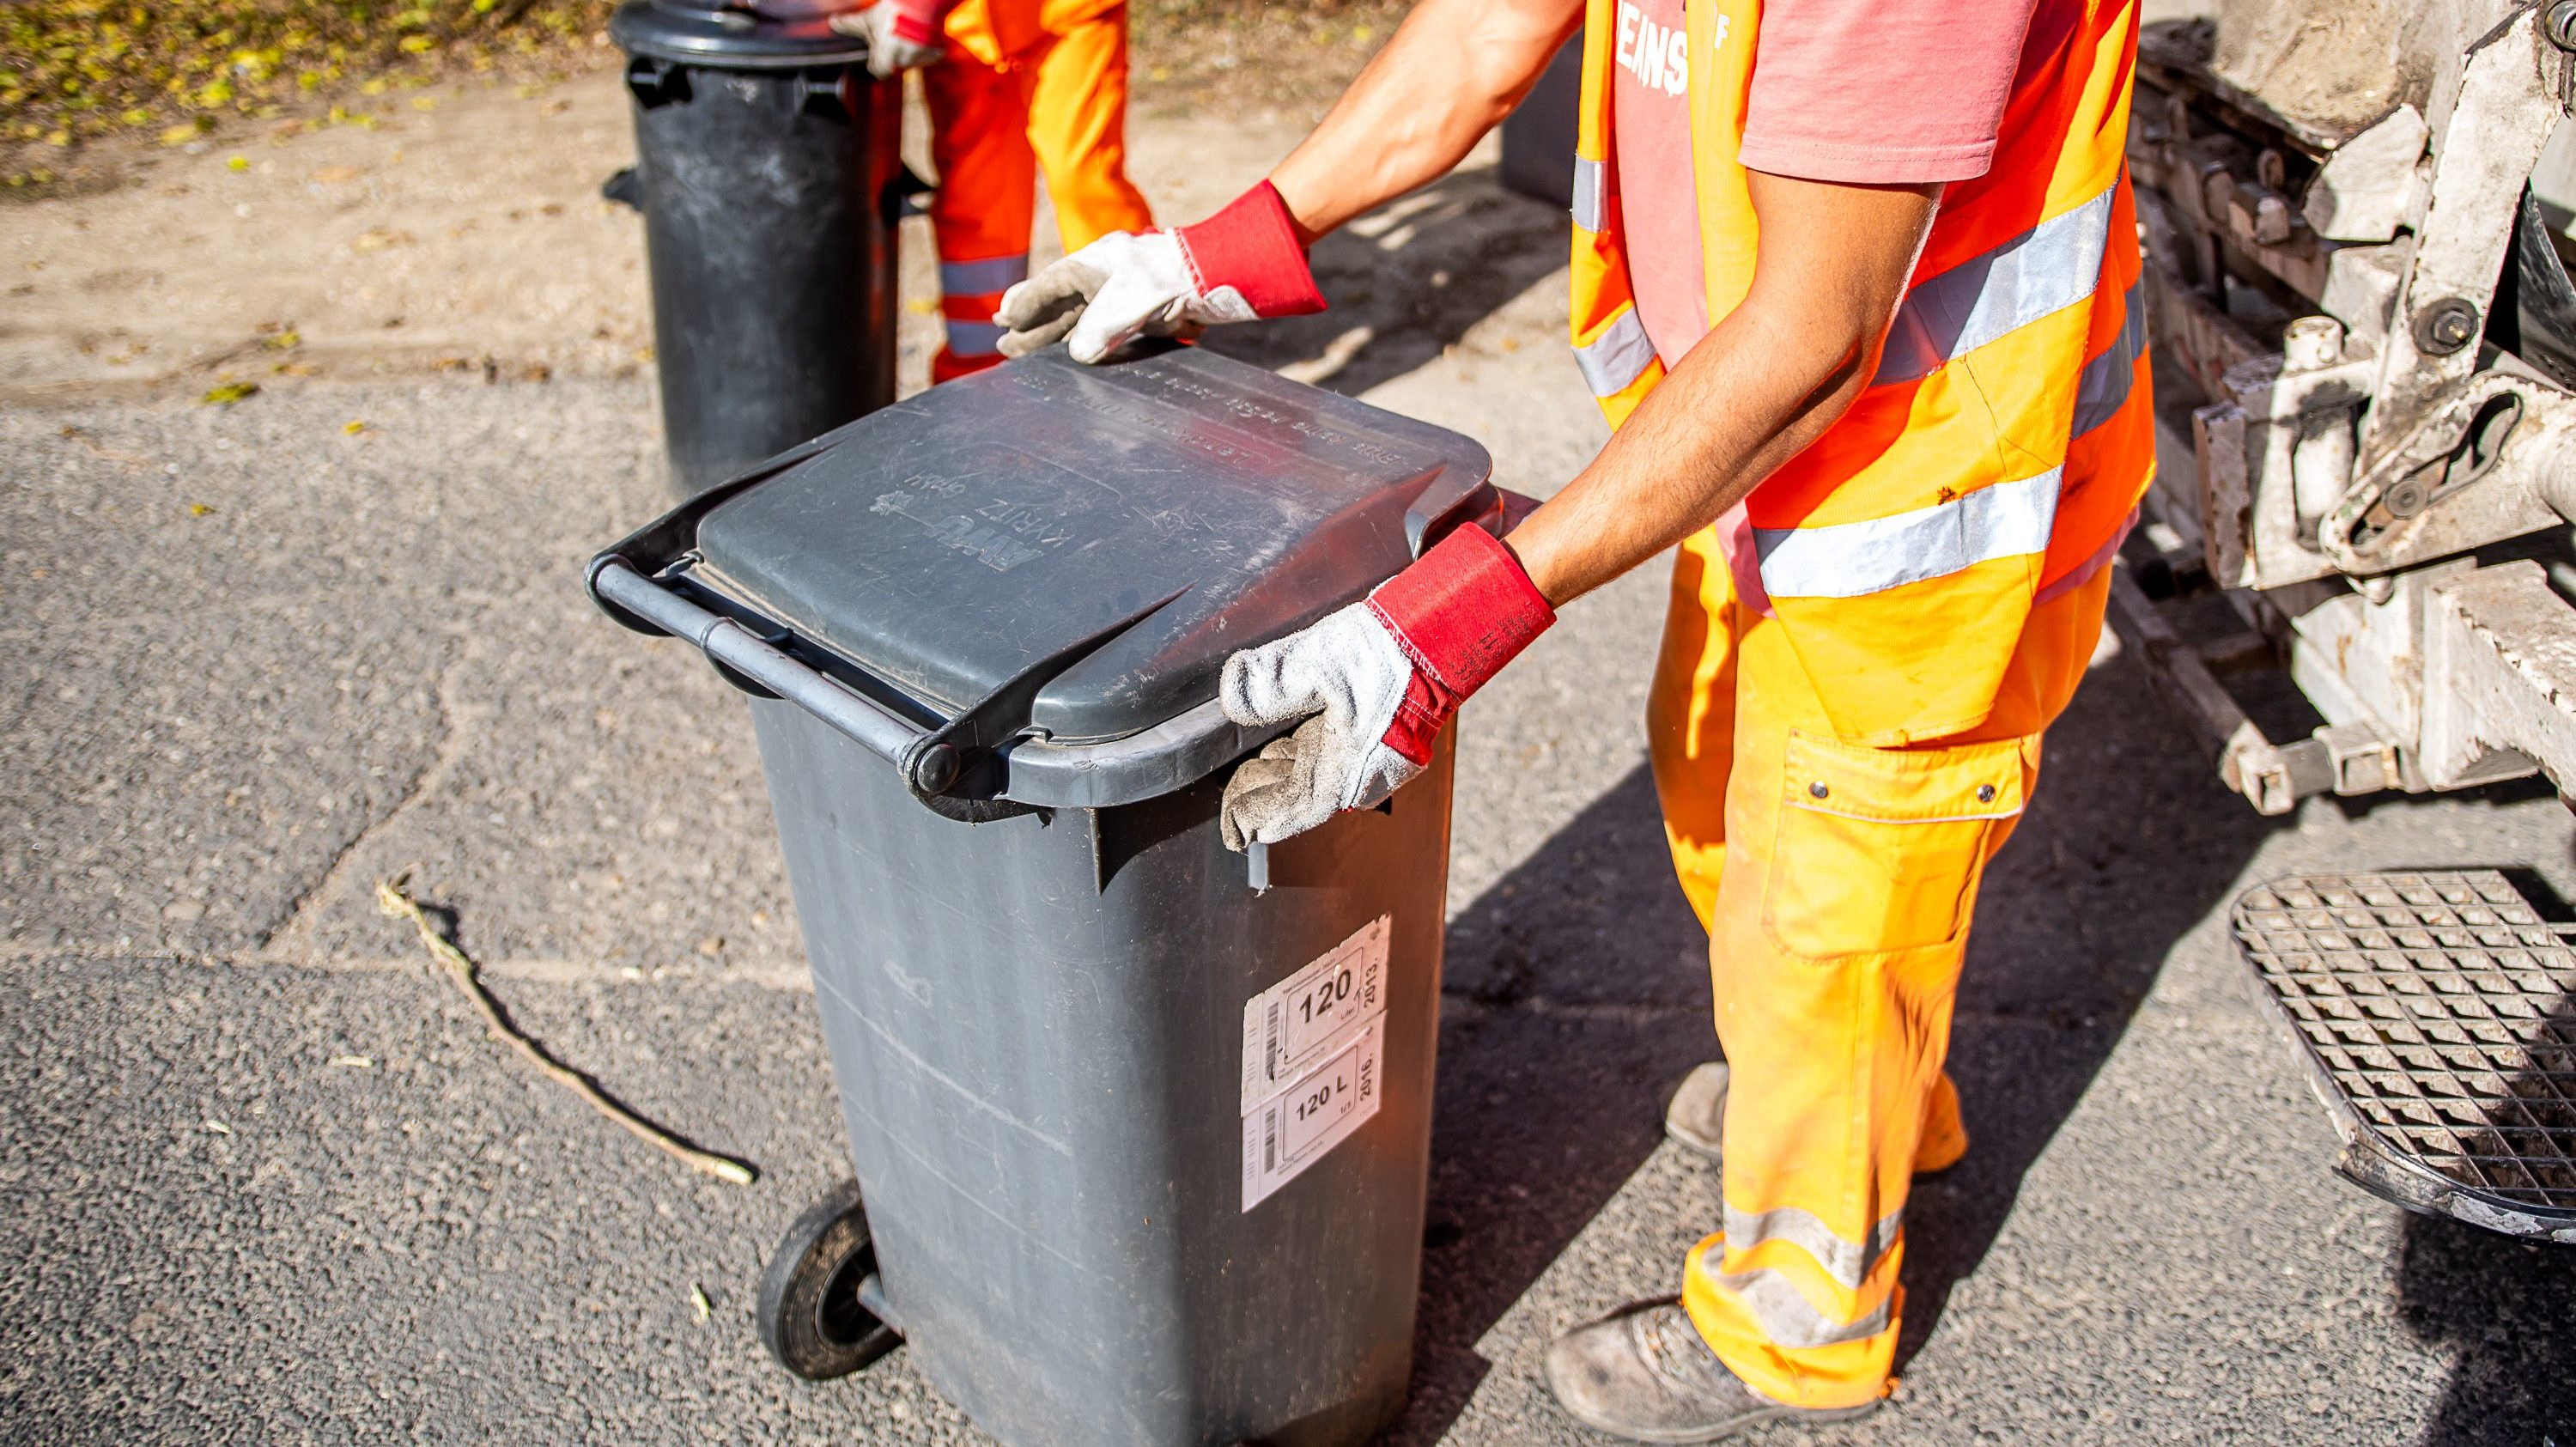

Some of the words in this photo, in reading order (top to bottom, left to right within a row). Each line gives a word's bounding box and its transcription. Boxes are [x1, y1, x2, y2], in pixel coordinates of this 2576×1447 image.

[1616, 0, 1689, 98] EANS
[1299, 969, 1351, 1024] 120
[1296, 1085, 1329, 1122] 120
[1336, 1075, 1347, 1094] L
